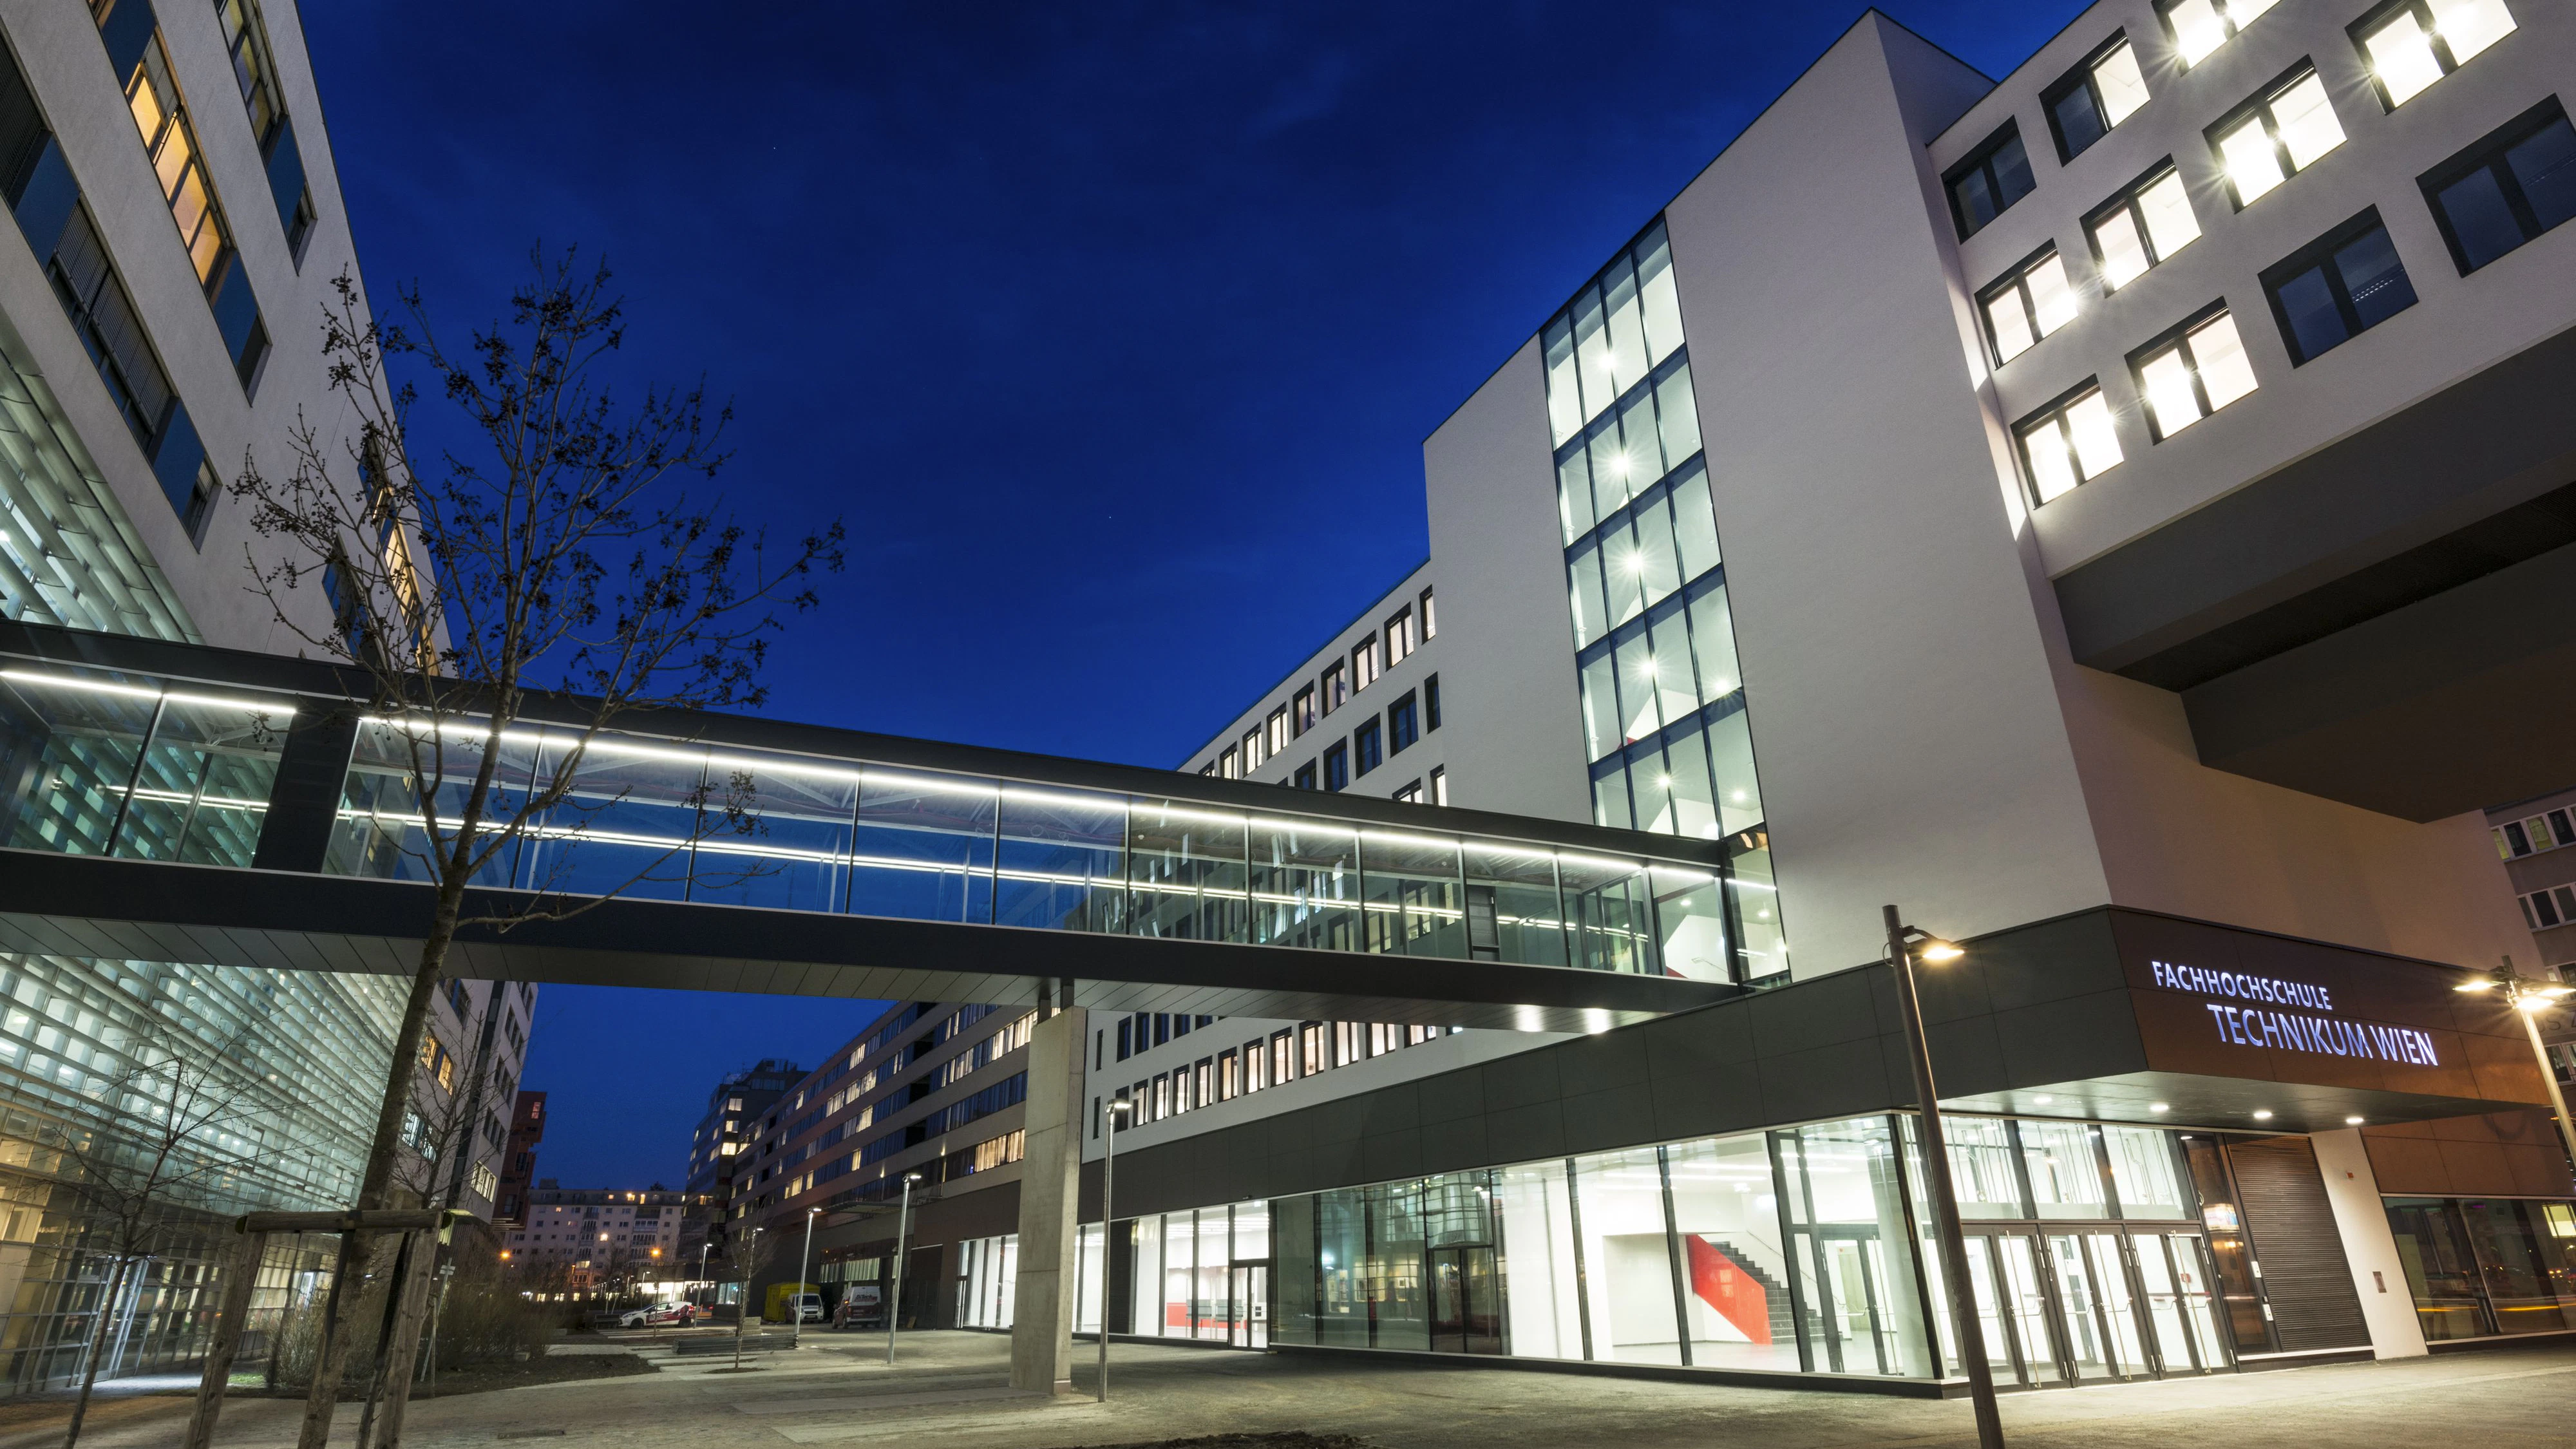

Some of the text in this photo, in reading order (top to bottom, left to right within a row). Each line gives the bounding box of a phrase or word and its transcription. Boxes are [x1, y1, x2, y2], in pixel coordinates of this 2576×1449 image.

[2152, 961, 2333, 1010] FACHHOCHSCHULE
[2206, 1004, 2438, 1066] TECHNIKUM WIEN
